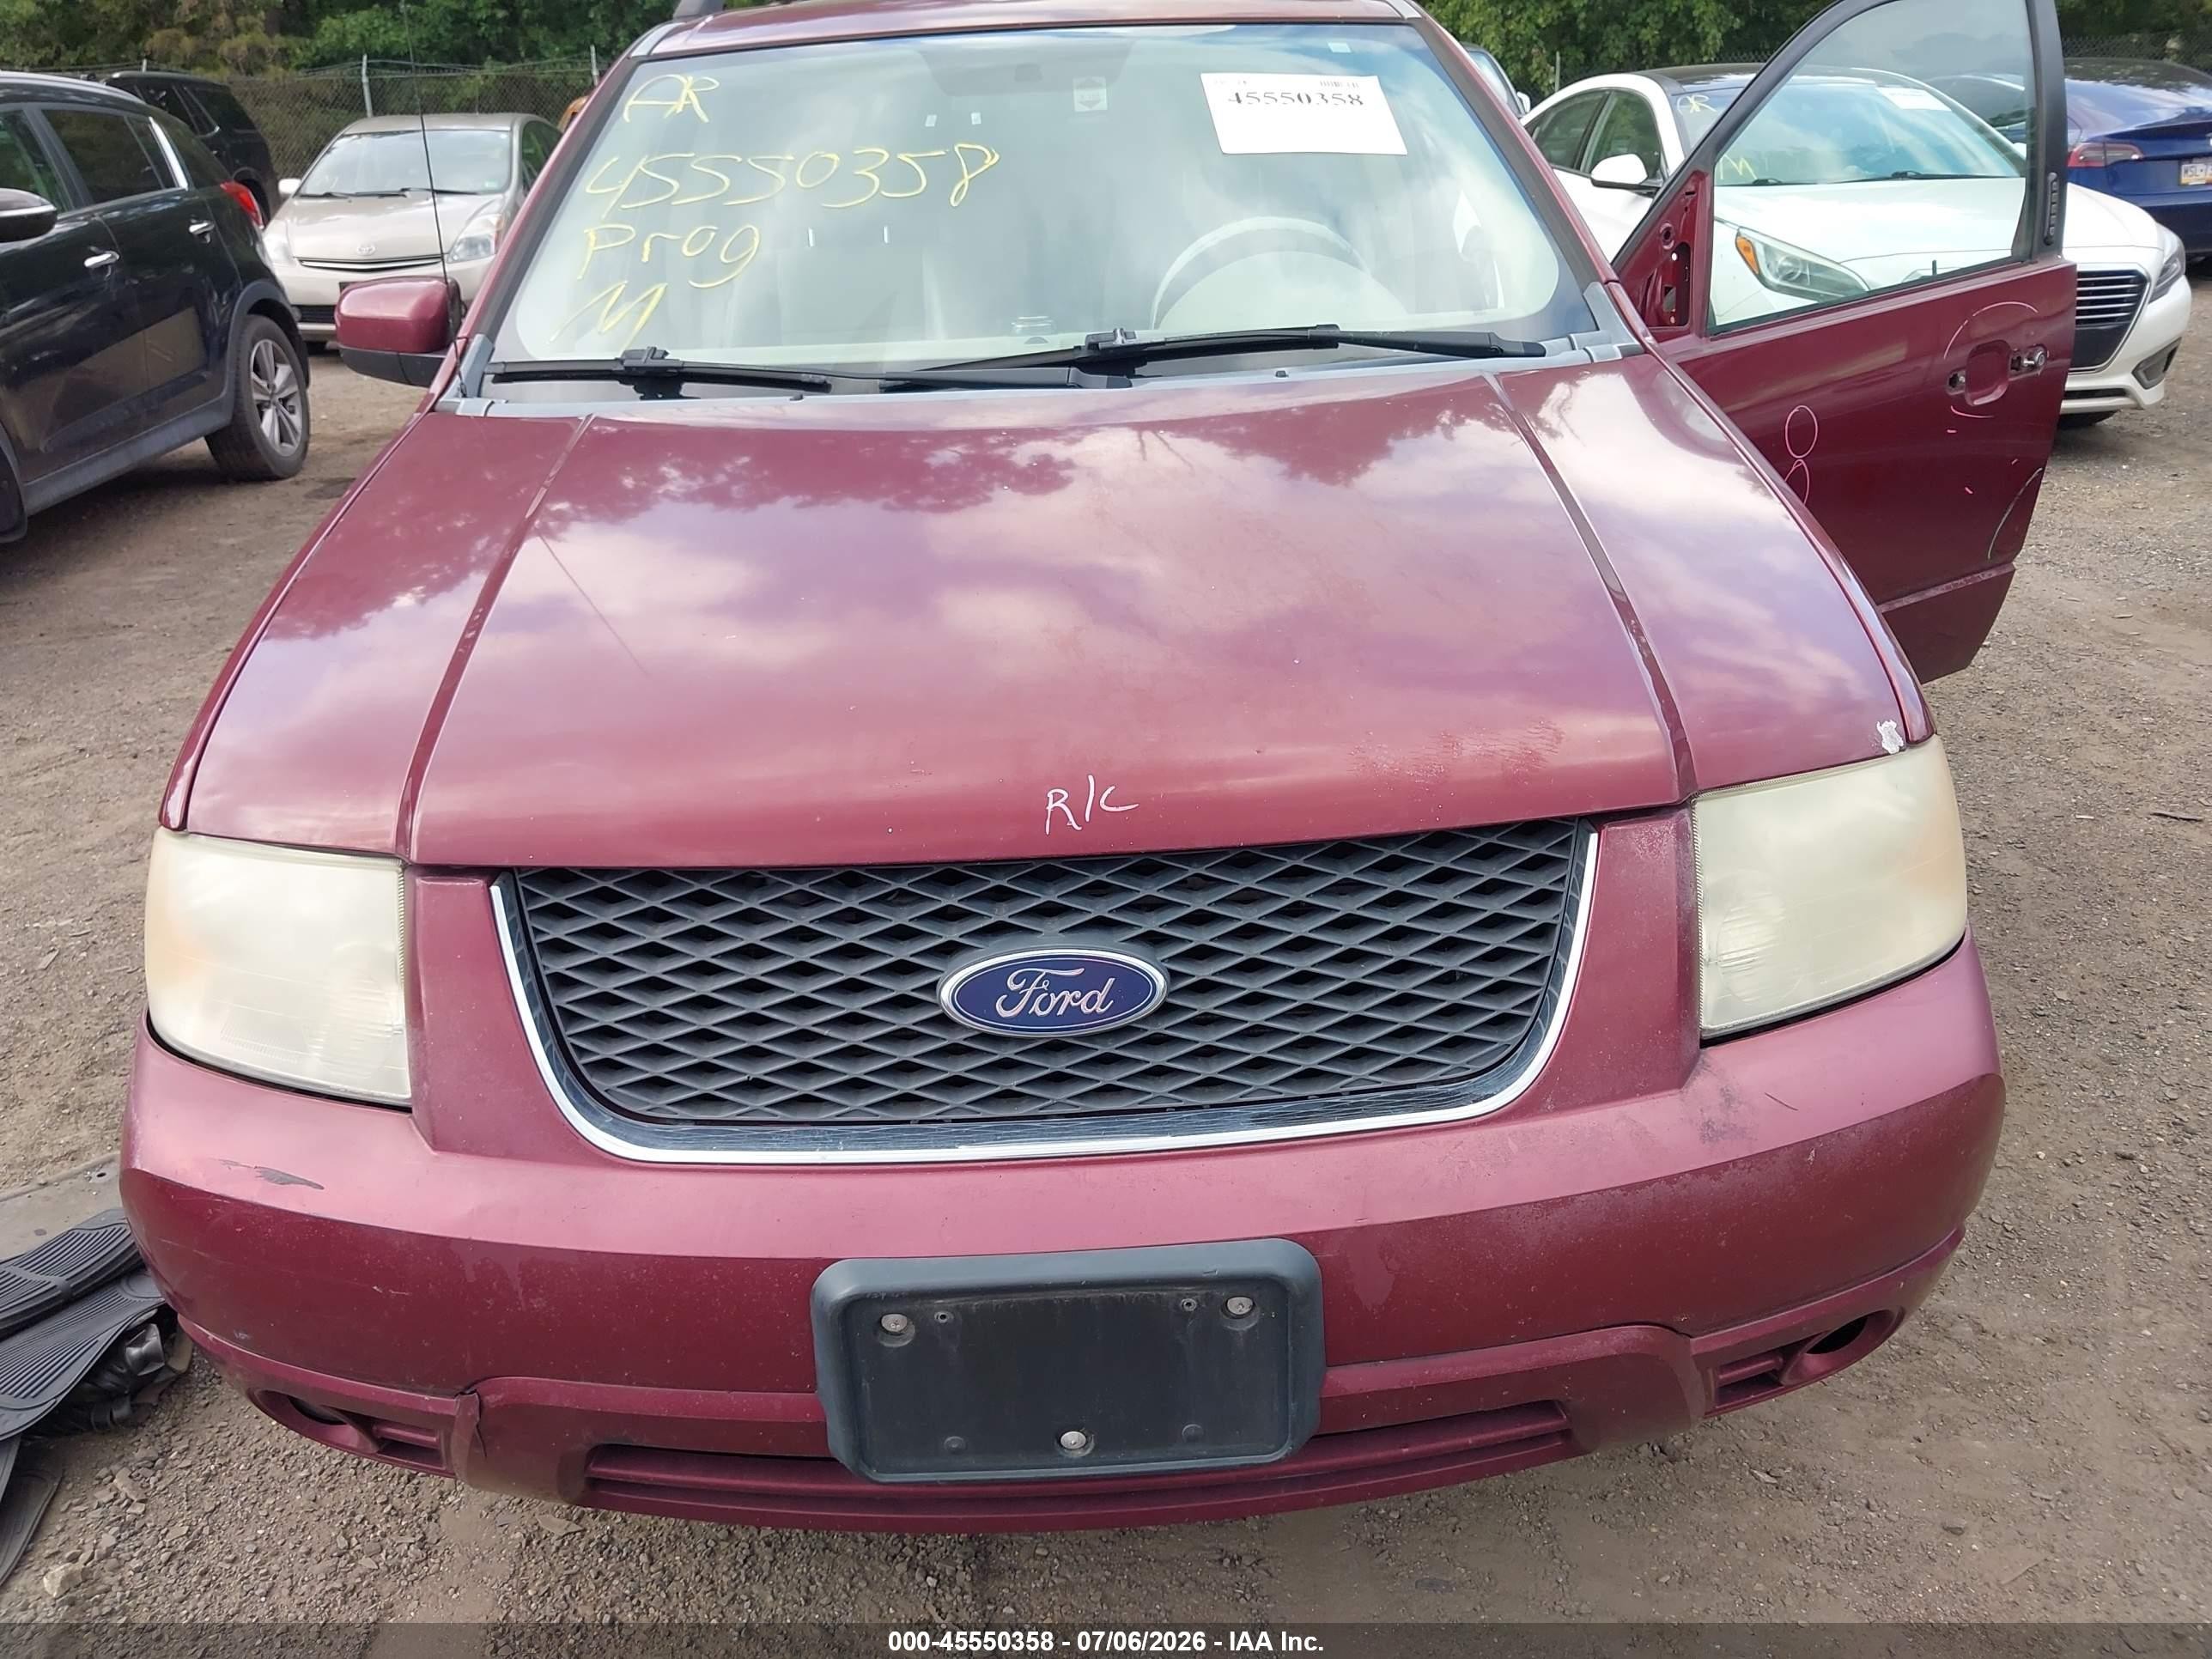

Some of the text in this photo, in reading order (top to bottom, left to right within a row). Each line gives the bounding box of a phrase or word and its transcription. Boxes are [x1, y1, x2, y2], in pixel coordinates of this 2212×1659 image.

[622, 74, 720, 123] AR
[585, 143, 1000, 219] 45550358
[575, 223, 760, 289] Prog
[994, 968, 1116, 1018] Ford
